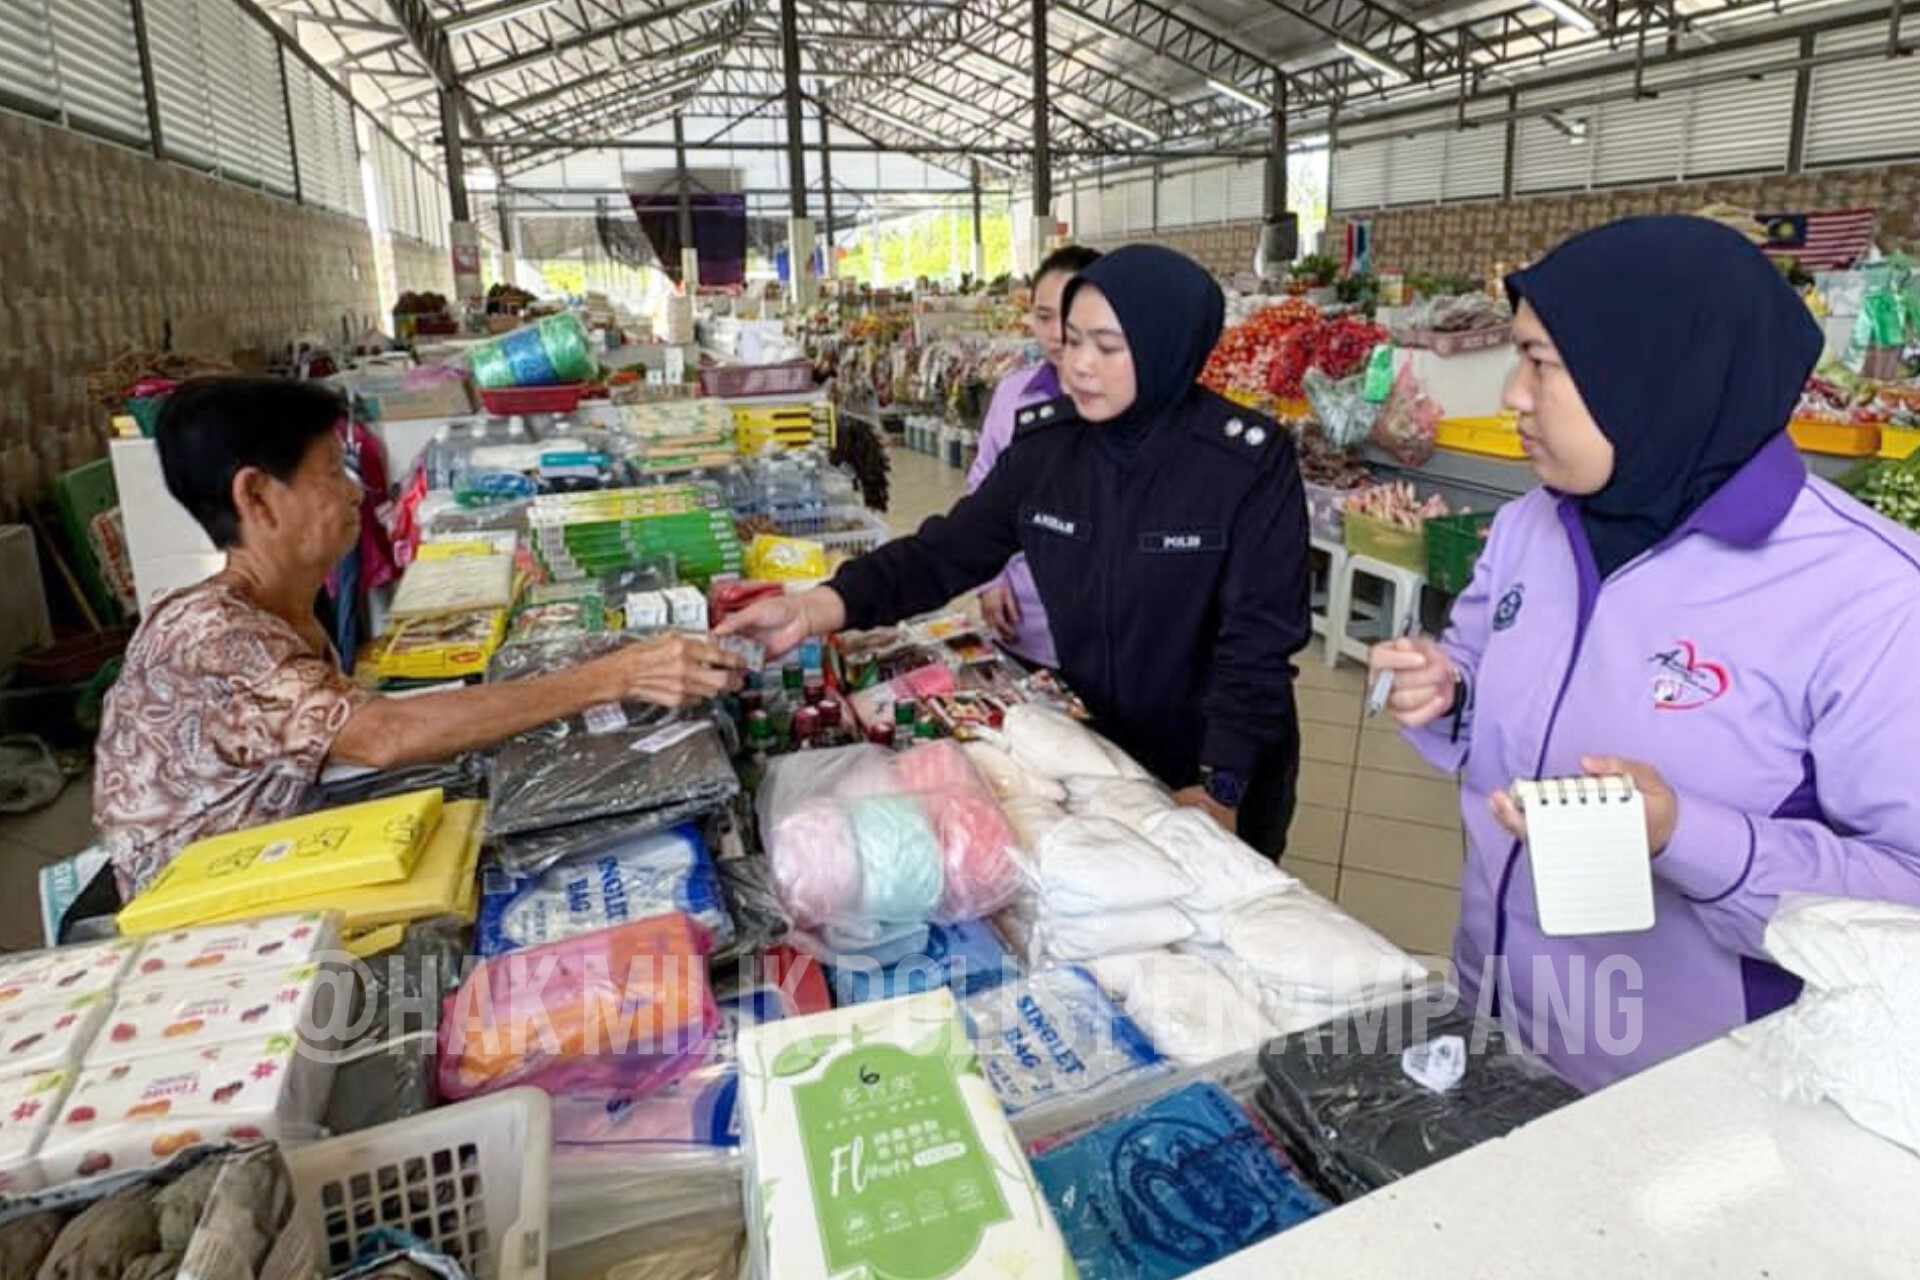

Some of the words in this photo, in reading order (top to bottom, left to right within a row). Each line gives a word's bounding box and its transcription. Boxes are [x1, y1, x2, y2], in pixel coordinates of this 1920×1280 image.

[568, 878, 591, 912] BAG
[1006, 1026, 1041, 1069] BAG
[1017, 994, 1086, 1074] SINGLET
